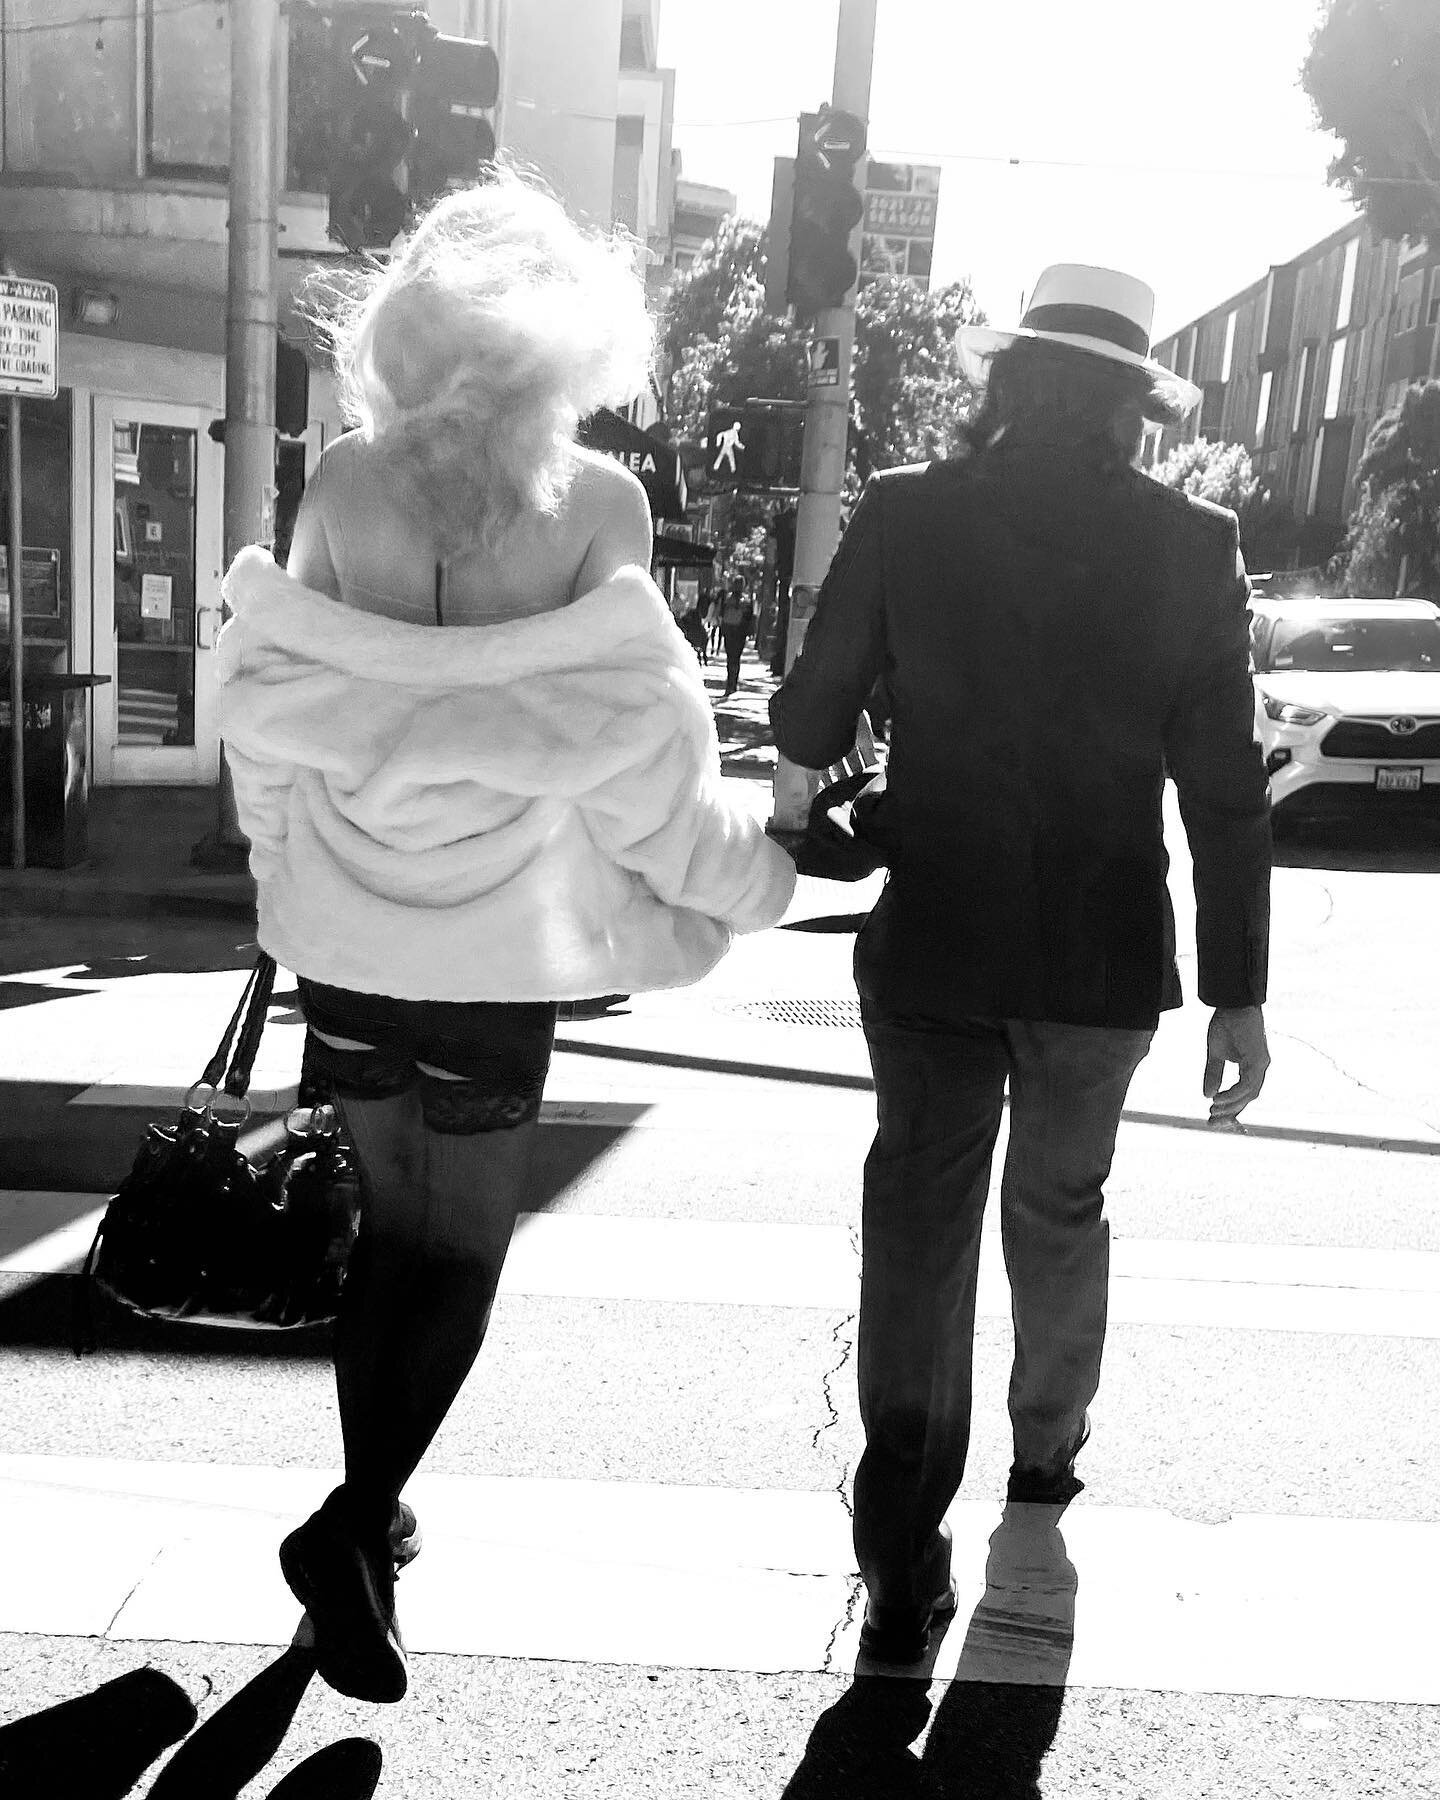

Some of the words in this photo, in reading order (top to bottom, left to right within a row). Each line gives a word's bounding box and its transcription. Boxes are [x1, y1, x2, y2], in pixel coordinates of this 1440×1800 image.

[3, 302, 52, 327] PARKING
[19, 327, 41, 342] TIME
[15, 359, 51, 375] LOADING
